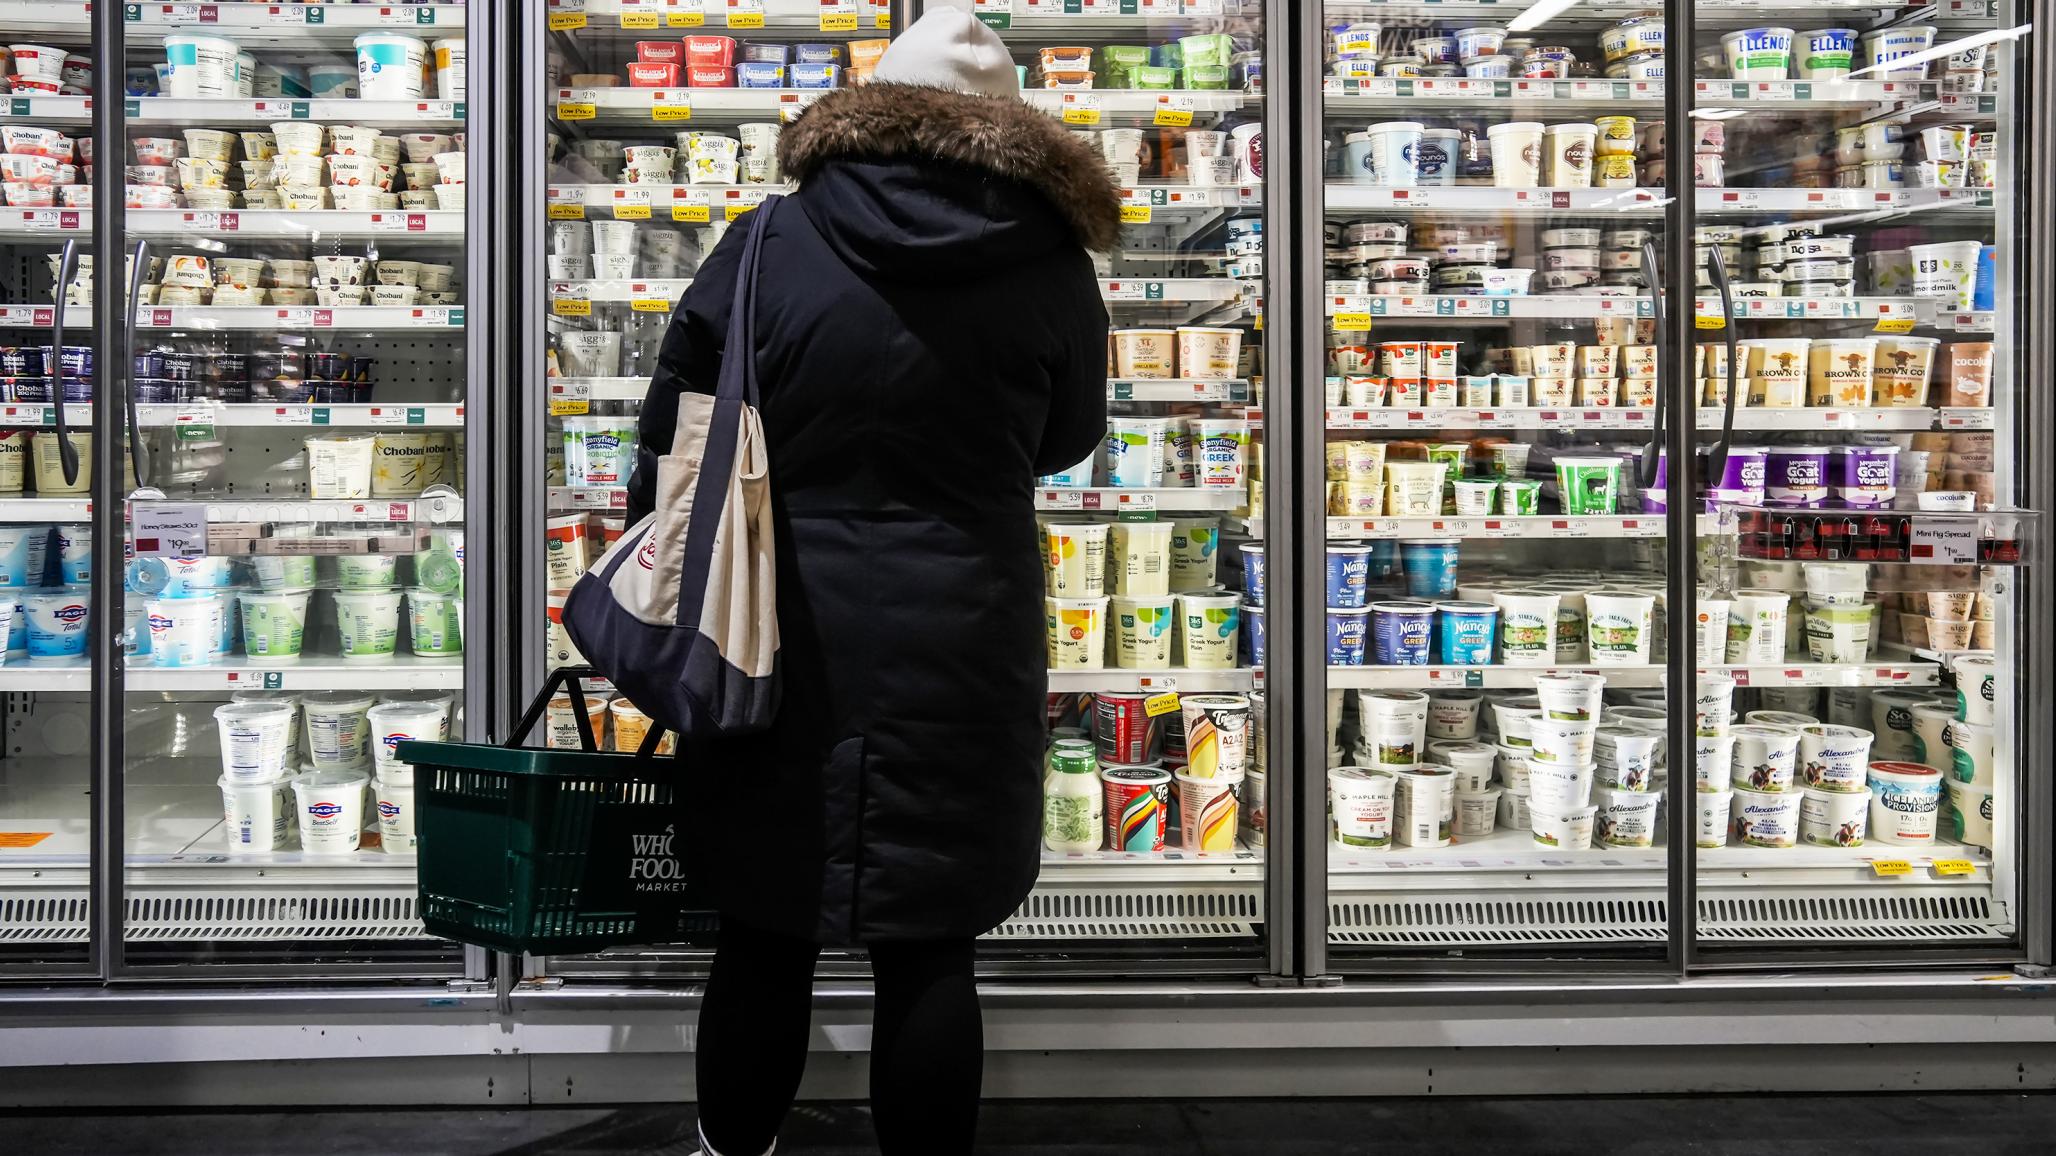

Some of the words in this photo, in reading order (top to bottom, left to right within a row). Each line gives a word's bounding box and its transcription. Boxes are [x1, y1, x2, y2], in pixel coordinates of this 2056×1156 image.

[1340, 34, 1369, 43] LENOS
[1640, 32, 1661, 42] ELLEN
[1886, 36, 1913, 44] VANILLA
[1606, 41, 1626, 52] ELLEN
[1740, 37, 1790, 51] ELLENOS
[1811, 38, 1853, 52] ELLENO
[1964, 48, 1978, 62] Sil
[1646, 68, 1664, 76] ELLE
[1792, 244, 1821, 254] nosa
[1921, 261, 1936, 270] 35
[0, 444, 24, 452] Chob
[1200, 438, 1236, 449] Sonyfield
[383, 446, 424, 456] Chobani
[1787, 467, 1819, 477] Goat
[1857, 467, 1889, 477] Goat
[1787, 477, 1819, 485] Yogurt
[1858, 477, 1889, 485] Yogurt
[1932, 531, 1944, 539] Fig
[1343, 563, 1368, 576] Nancy
[62, 623, 80, 632] Total
[1336, 623, 1366, 635] Nancy
[1400, 623, 1430, 635] Nancy
[1813, 619, 1832, 630] Valley
[1159, 698, 1177, 708] Price
[1887, 802, 1938, 812] PROVISIONS
[636, 882, 687, 892] MARKET
